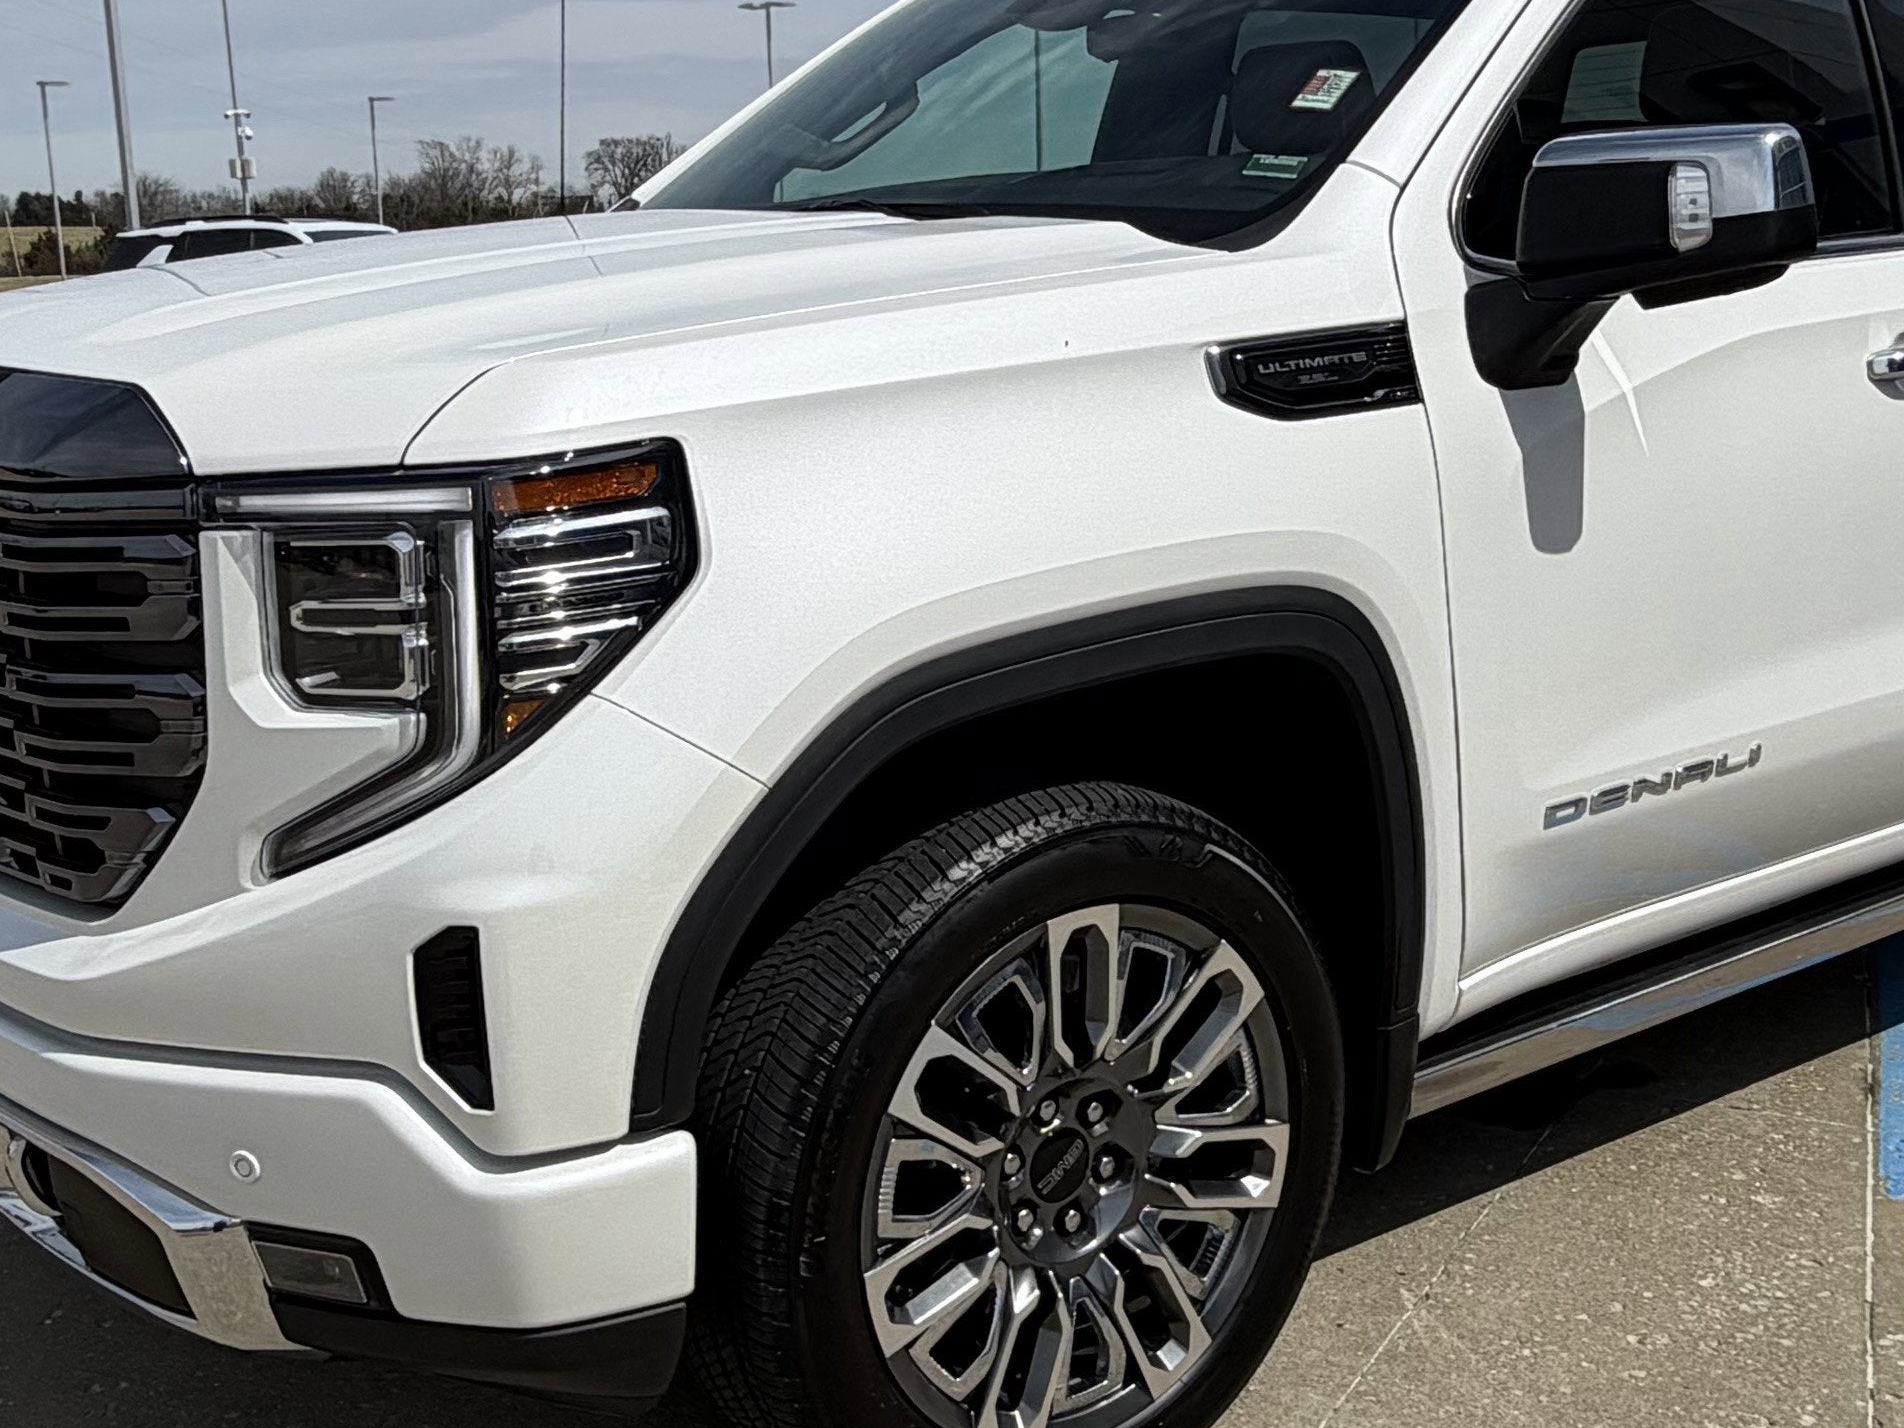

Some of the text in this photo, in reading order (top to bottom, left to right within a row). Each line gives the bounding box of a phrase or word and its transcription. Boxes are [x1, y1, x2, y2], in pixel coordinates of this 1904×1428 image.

[1257, 351, 1367, 374] ULTIMATE
[1543, 740, 1762, 830] DENALI
[1037, 1138, 1085, 1195] GMC
